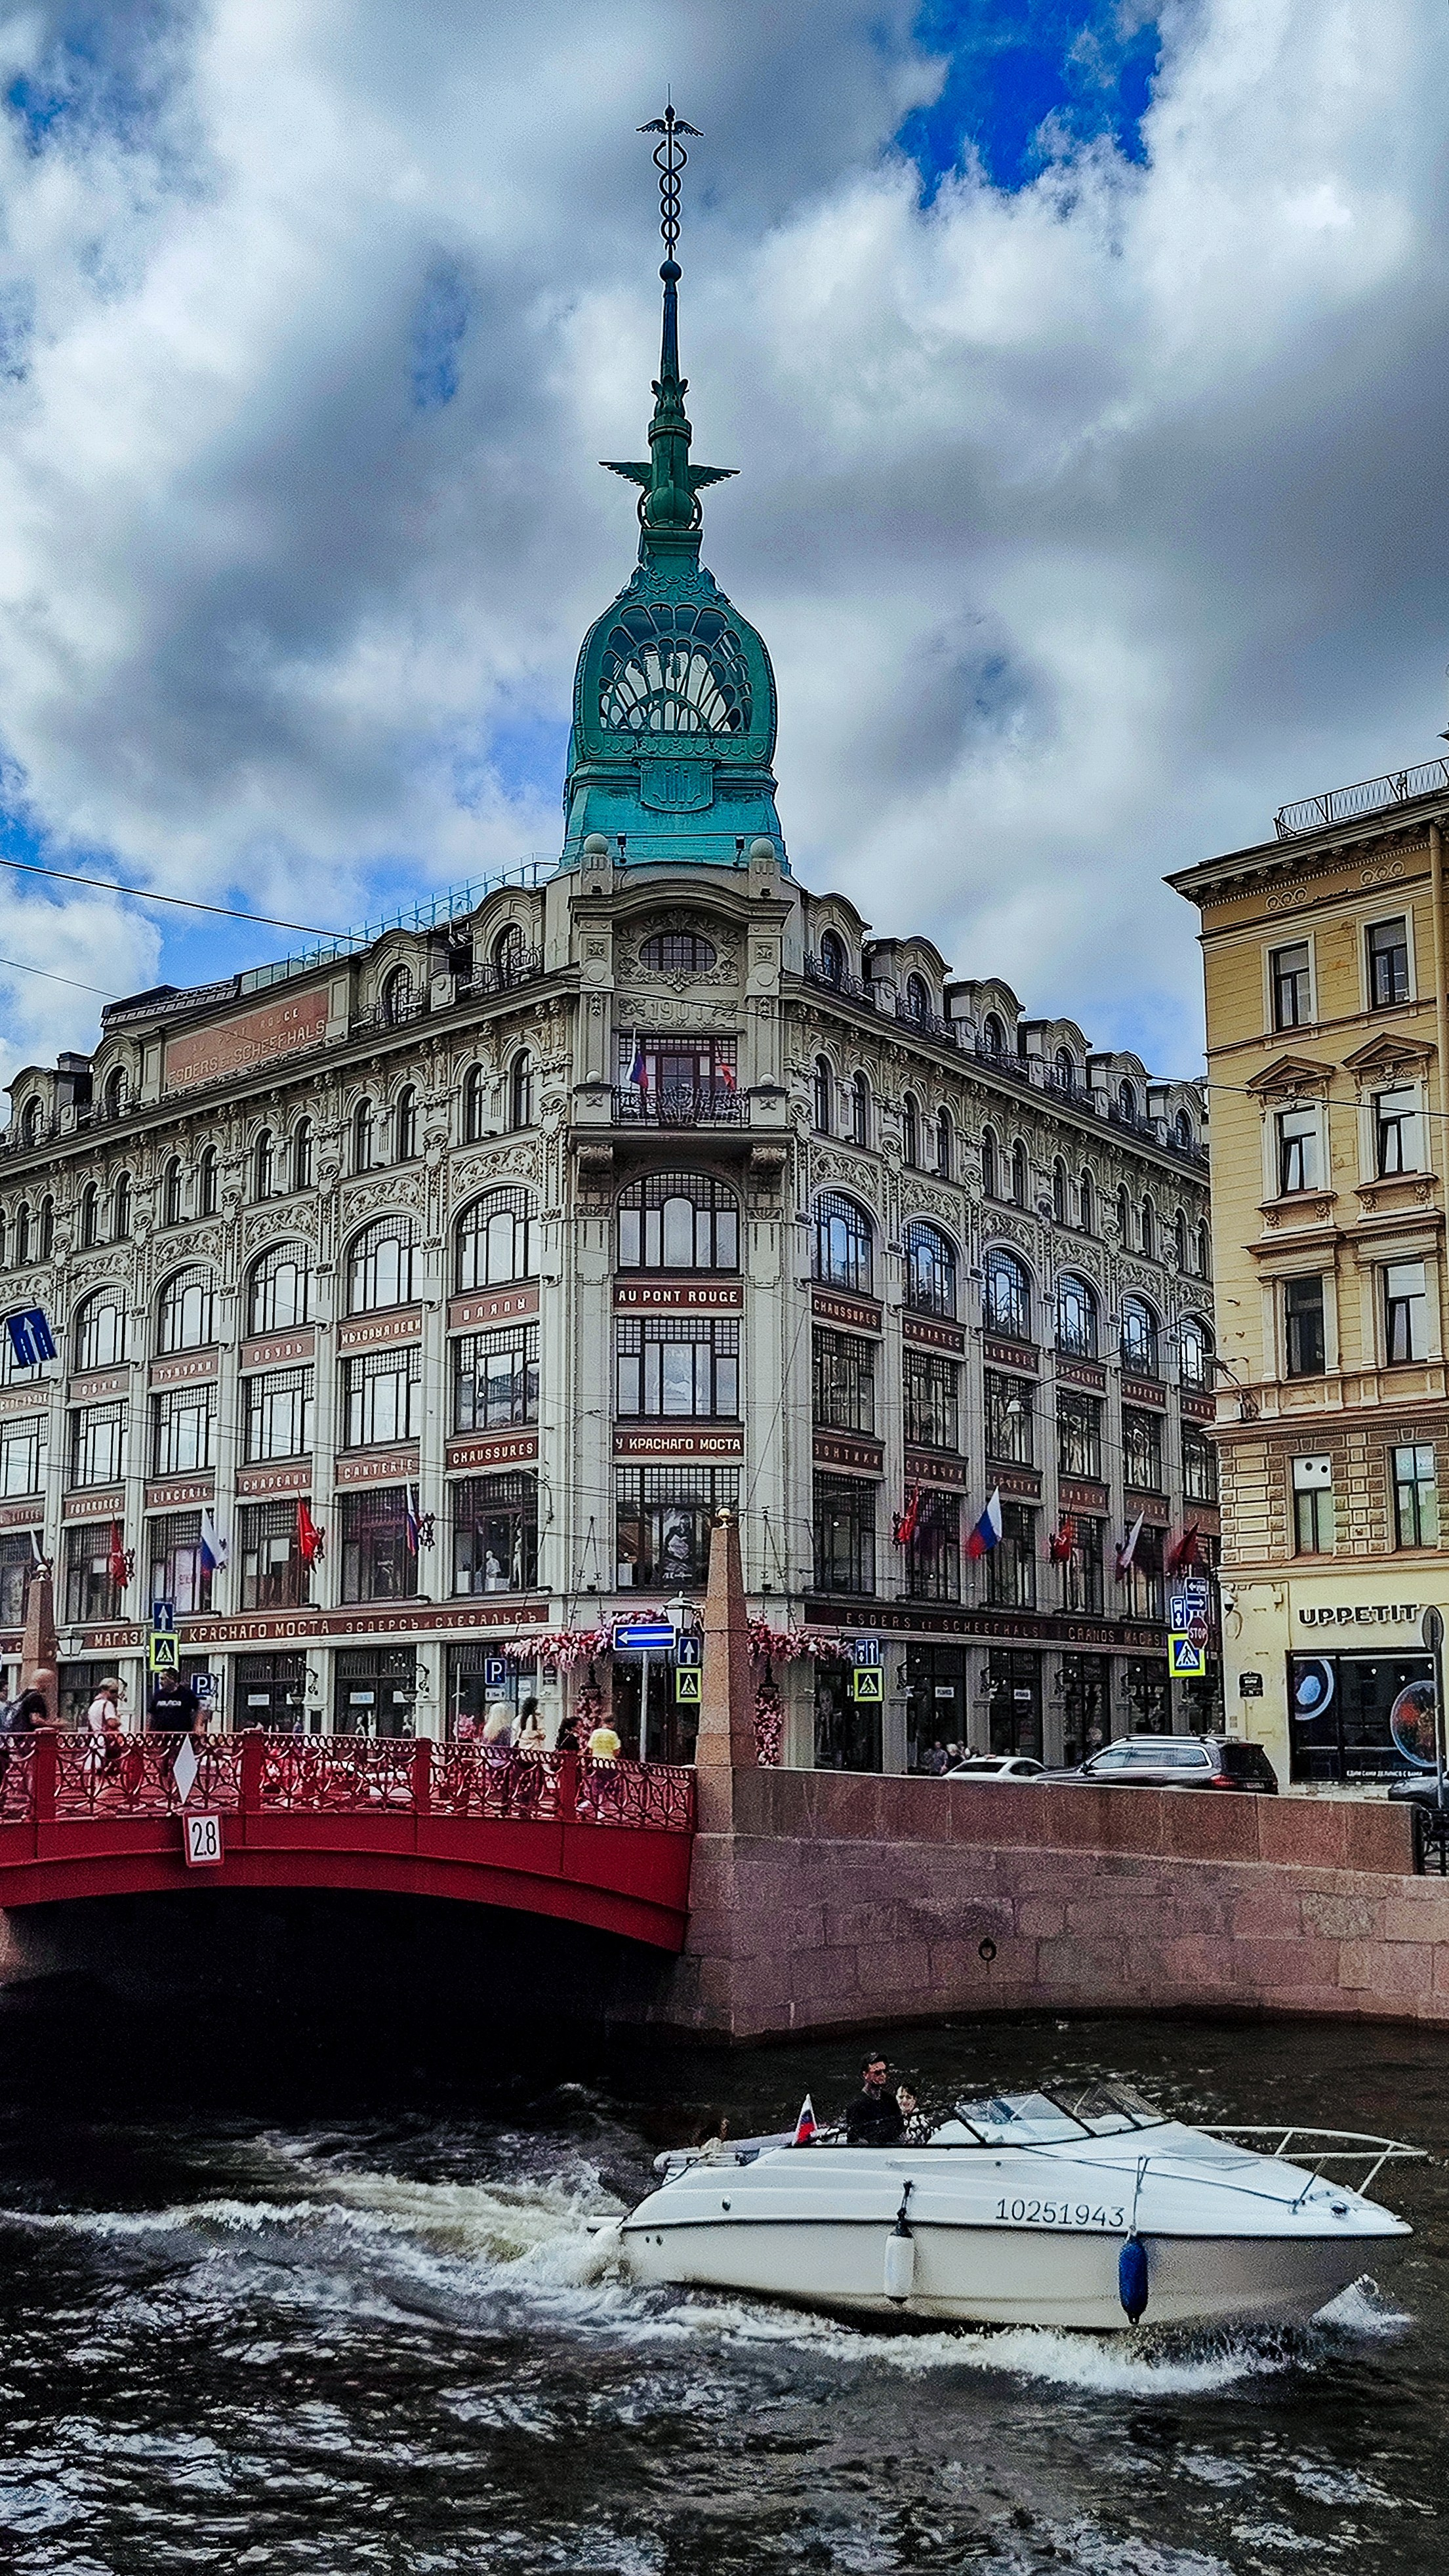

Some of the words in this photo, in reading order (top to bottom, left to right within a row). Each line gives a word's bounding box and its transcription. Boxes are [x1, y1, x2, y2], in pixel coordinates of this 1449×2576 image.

[169, 1056, 218, 1086] ESDERS
[233, 1019, 326, 1063] SCHEEFHALS
[618, 1290, 638, 1302] AU
[643, 1290, 682, 1303] PONT
[688, 1290, 737, 1303] ROUGE
[813, 1299, 877, 1326] CHAUSSURES
[253, 1343, 304, 1363] ОБУВЬ
[453, 1442, 534, 1465] CHAUSSURES
[615, 1438, 623, 1449] У
[629, 1438, 694, 1450] КРАСНАГО
[699, 1438, 741, 1450] МОСТА
[243, 1473, 308, 1492] CHAPEAUX
[846, 1612, 911, 1629] ESDERS
[943, 1620, 1039, 1638] SCHEEFHALS
[1299, 1604, 1418, 1626] UPPETIT
[189, 1623, 268, 1641] КРАСНАГО
[275, 1620, 330, 1637] МОСТА
[1189, 1627, 1208, 1639] STOP
[491, 1662, 502, 1682] P
[197, 1676, 208, 1694] P
[192, 1820, 217, 1856] 2.8
[995, 2198, 1125, 2228] 10251943
